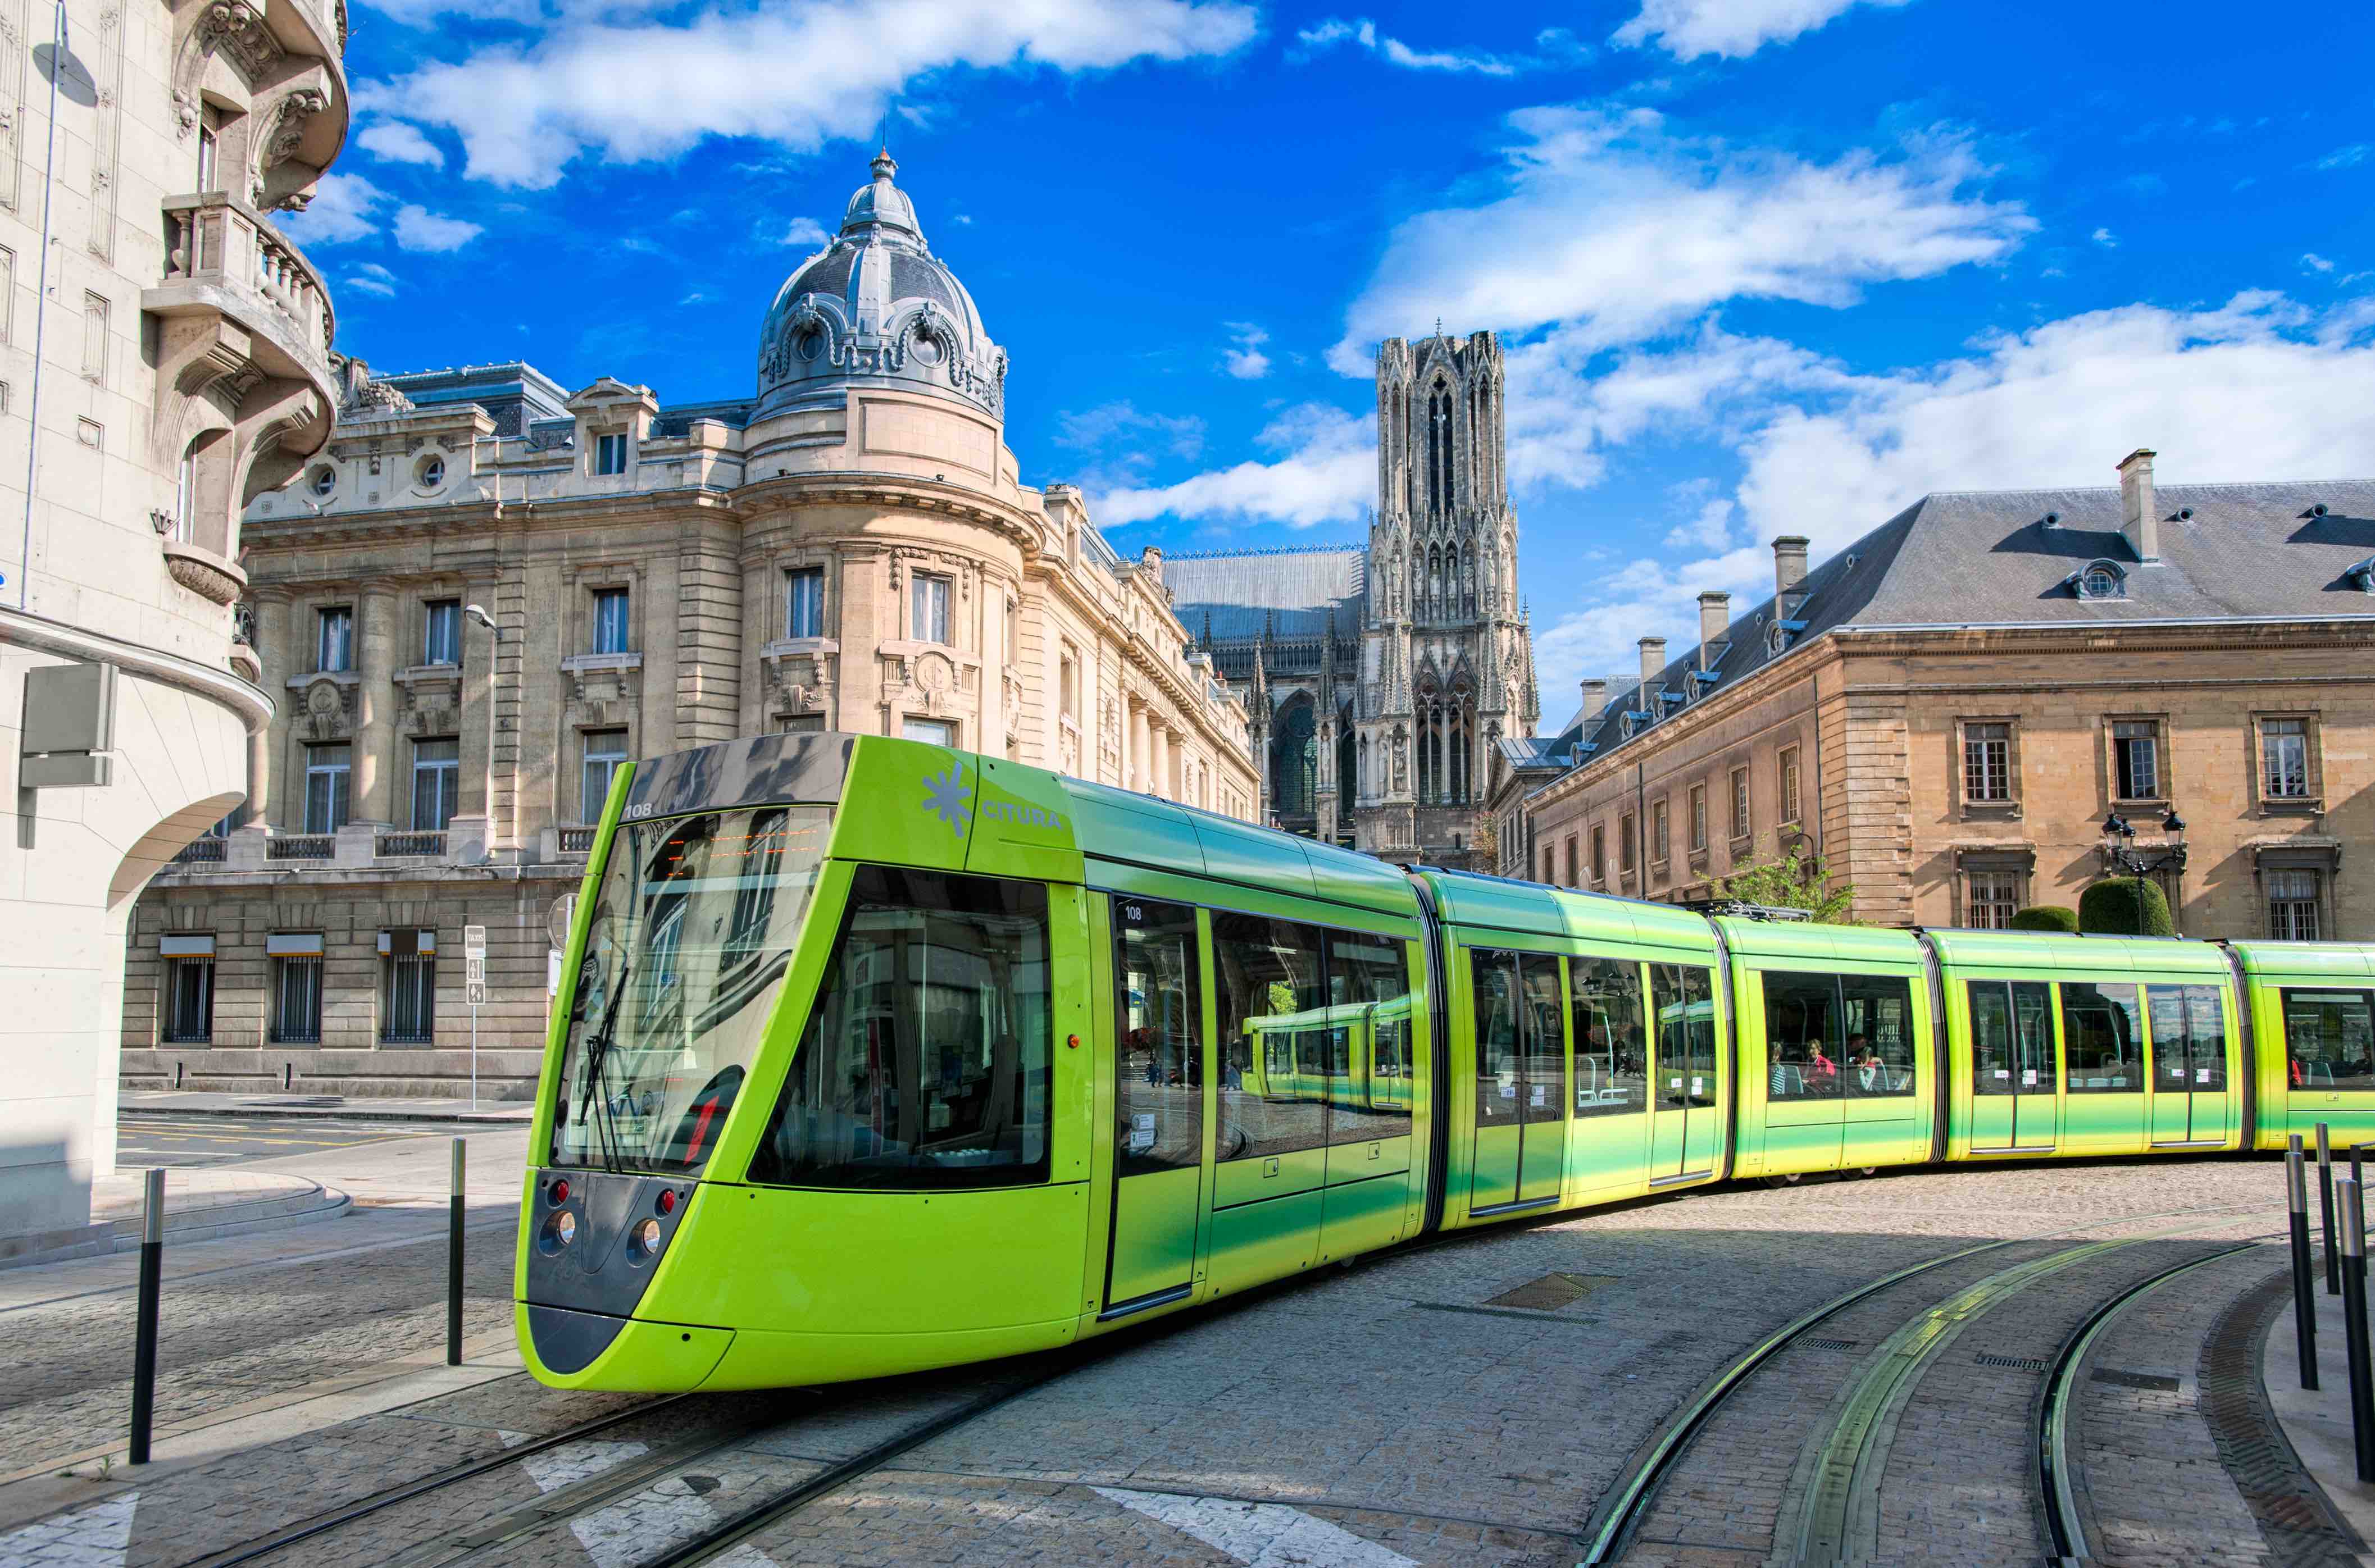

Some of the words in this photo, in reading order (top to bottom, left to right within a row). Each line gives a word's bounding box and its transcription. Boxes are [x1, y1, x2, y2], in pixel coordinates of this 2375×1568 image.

[624, 803, 652, 818] 108
[982, 800, 1063, 831] CITURA
[1125, 905, 1142, 920] 108
